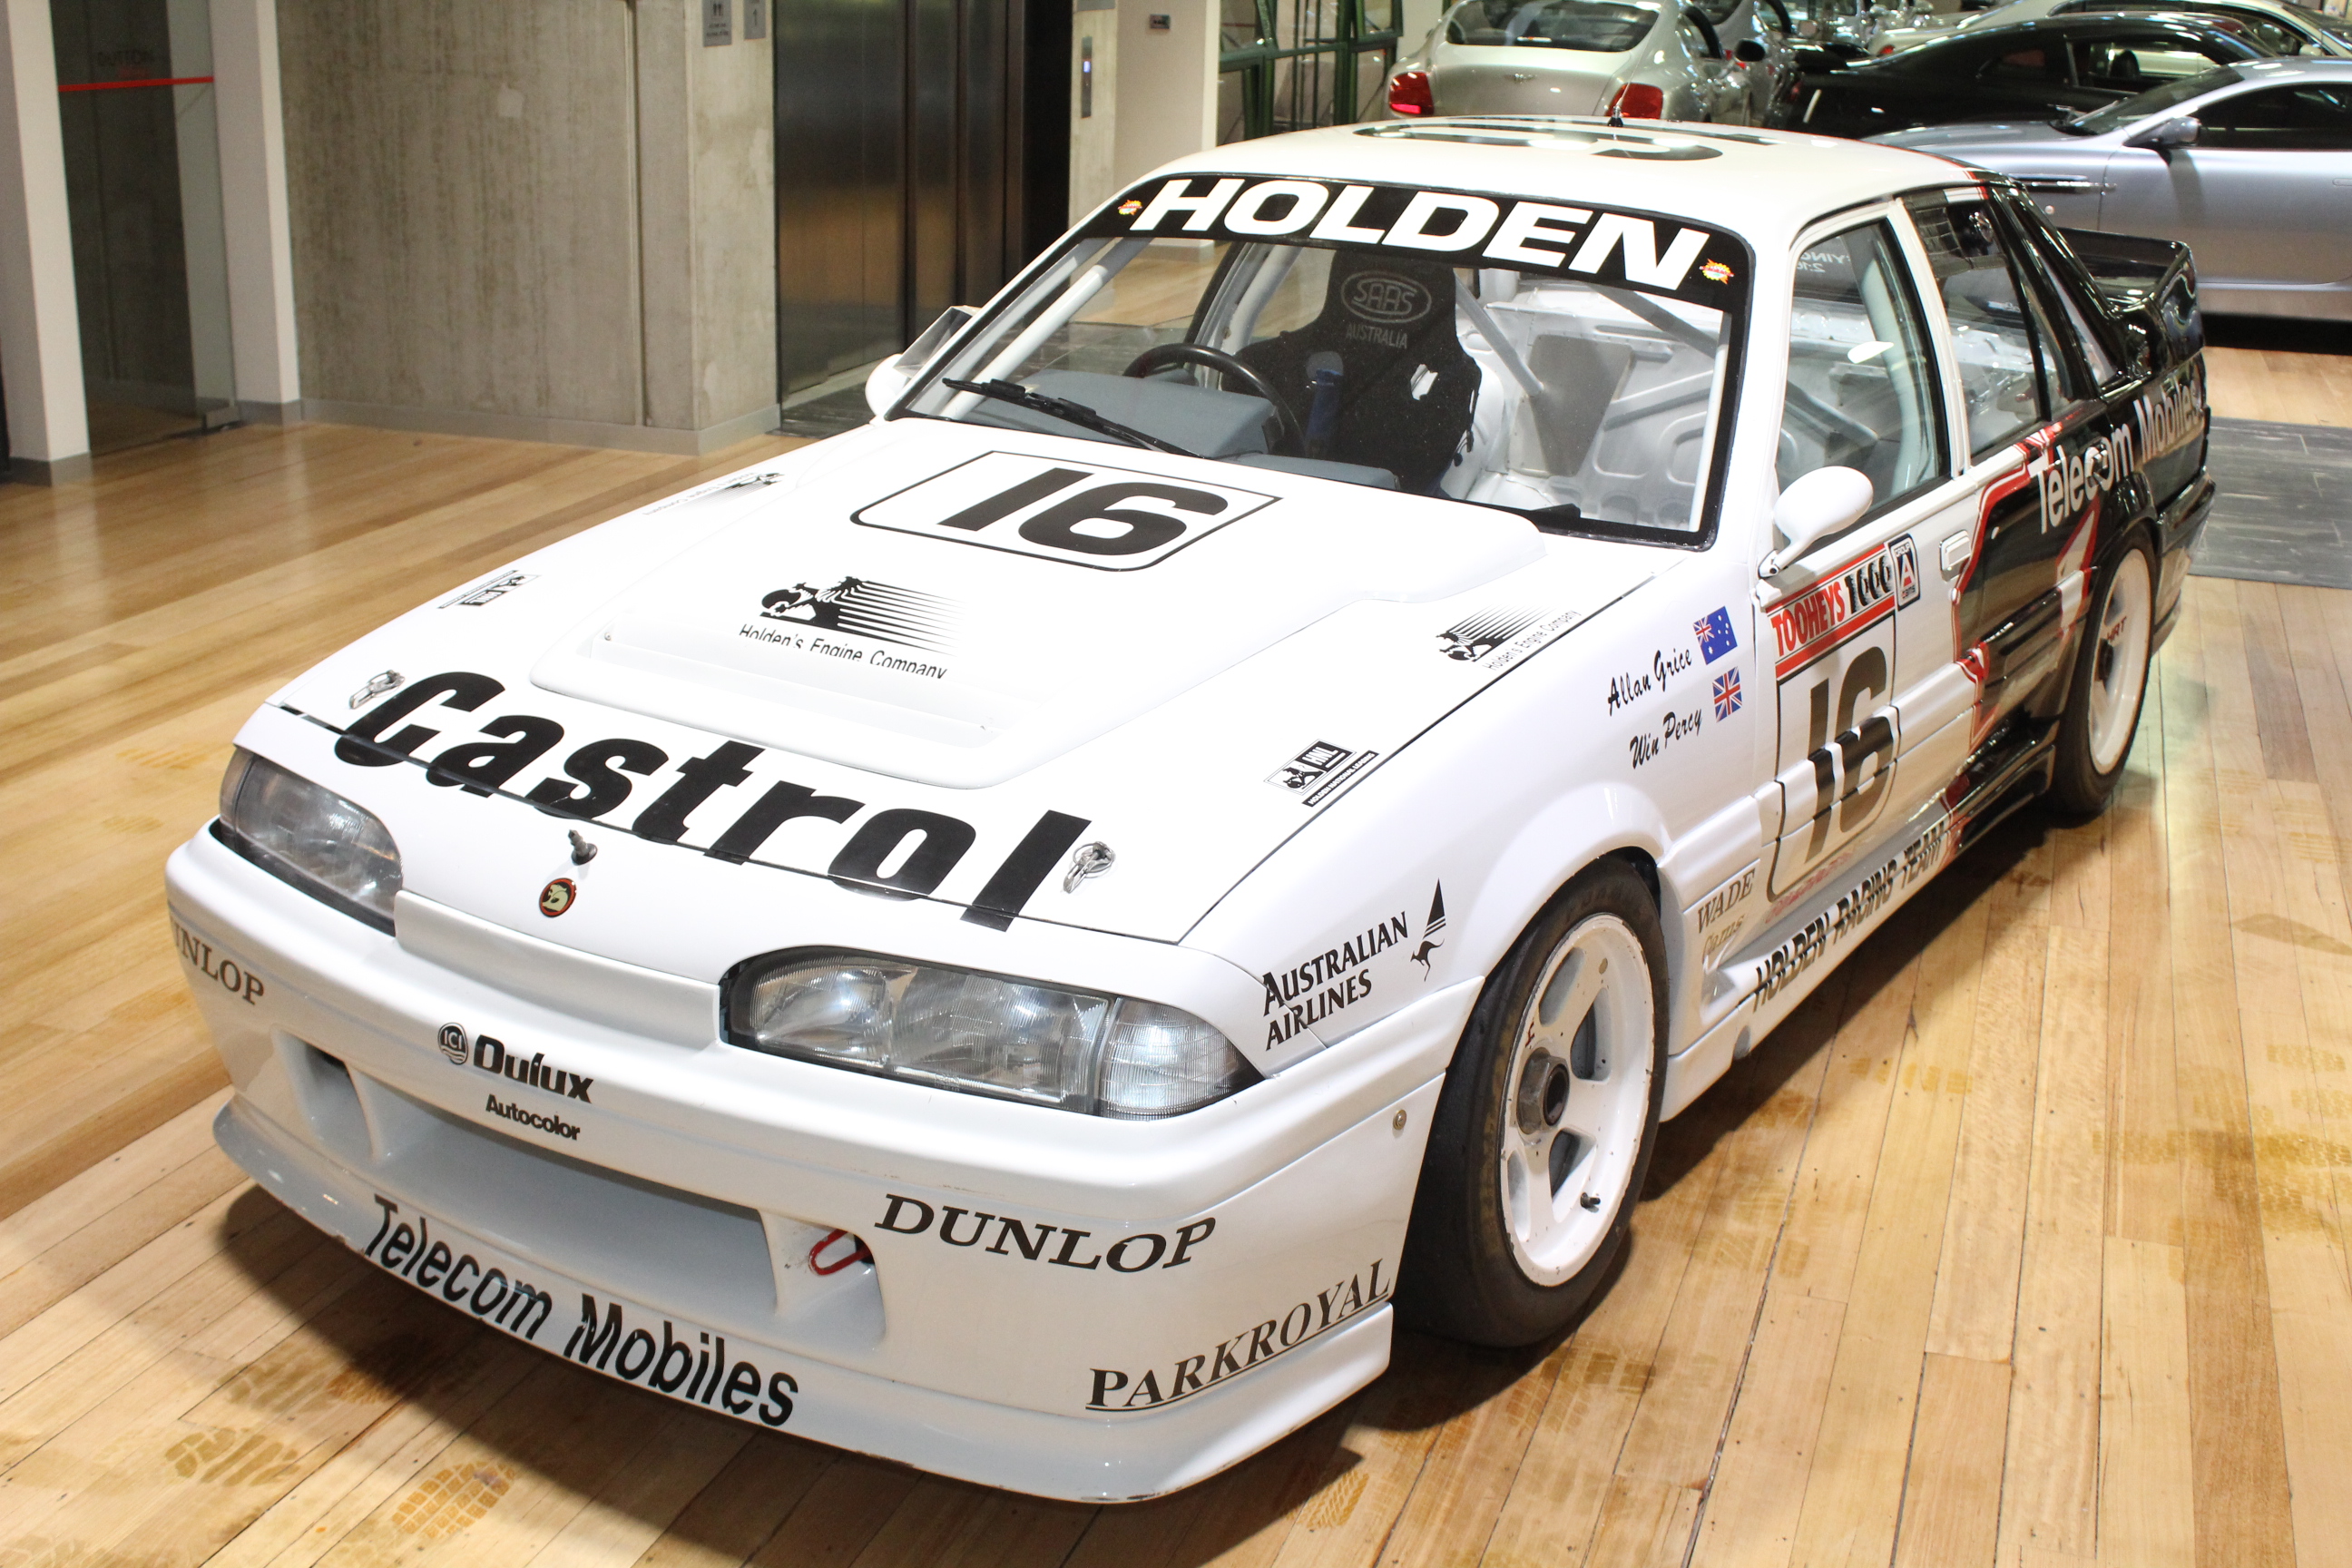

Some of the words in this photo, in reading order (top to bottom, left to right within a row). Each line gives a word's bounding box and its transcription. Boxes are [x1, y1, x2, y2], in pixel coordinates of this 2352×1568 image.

[1130, 178, 1710, 290] HOLDEN
[1346, 322, 1408, 349] AUSTRALIA
[1352, 279, 1417, 316] SAAS
[937, 467, 1229, 556] 16
[2027, 423, 2133, 535] Telecom
[1901, 554, 1916, 589] A
[739, 623, 804, 650] Holden's
[809, 638, 863, 662] Engine
[869, 650, 947, 681] Company
[1482, 648, 1524, 671] Holden's
[1514, 631, 1548, 649] Engine
[1539, 610, 1583, 632] Company
[1770, 581, 1846, 658] TOOHEYS
[1608, 671, 1651, 717] Allan
[1653, 647, 1692, 693] Grice
[1301, 746, 1339, 766] HNL
[1630, 732, 1660, 770] Win
[1662, 708, 1702, 750] Percy
[1804, 645, 1895, 864] 16
[334, 671, 1093, 933] Castrol
[1307, 784, 1333, 805] HOLDEN
[1329, 765, 1358, 788] NATIONAL
[1698, 867, 1756, 934] WADE
[1753, 911, 1830, 1014] HOLDEN
[1833, 858, 1898, 946] RACING
[1901, 820, 1945, 889] TEAM
[1262, 910, 1408, 1017] AUSTRALIAN
[1265, 968, 1372, 1052] AIRLINES
[444, 1029, 464, 1051] ICI
[473, 1034, 594, 1105] Dulux
[485, 1093, 581, 1142] Autocolor
[874, 1193, 1217, 1273] DUNLOP
[363, 1192, 553, 1341] Telecom
[563, 1292, 799, 1427] Mobiles
[1086, 1258, 1391, 1409] PARKROYAL
